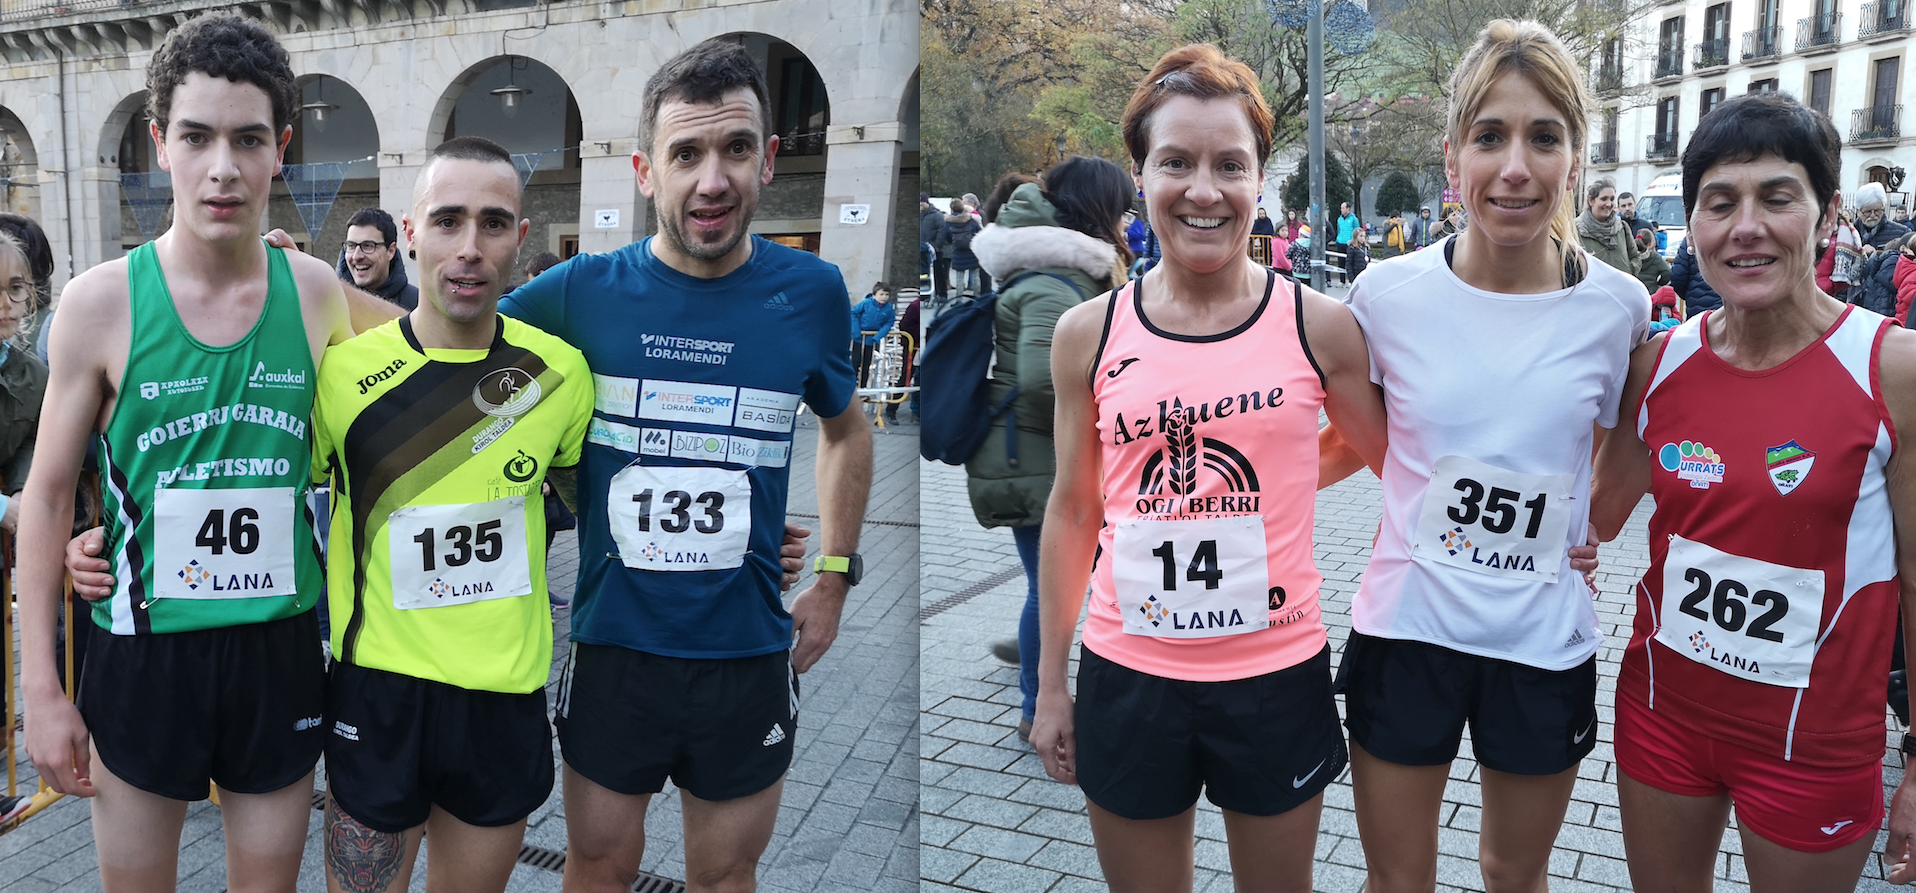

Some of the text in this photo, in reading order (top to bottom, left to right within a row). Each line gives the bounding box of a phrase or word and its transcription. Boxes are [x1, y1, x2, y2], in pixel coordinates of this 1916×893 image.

[645, 347, 727, 366] LORAMENDI
[655, 335, 734, 354] INTERSPORT
[265, 368, 304, 384] auxkal
[657, 391, 732, 407] INTERSPORT
[661, 403, 714, 414] LORAMENDI
[746, 396, 779, 404] AKADEMIA
[137, 403, 306, 452] GOIERRI GARAIA
[1114, 387, 1284, 445] Azkuene
[472, 417, 503, 443] DURANGO
[474, 419, 512, 451] KIROL TALDEA
[155, 458, 290, 489] ATLETISMO
[1680, 461, 1724, 474] URRATS
[632, 488, 725, 534] 133
[1136, 496, 1260, 514] OGI BERRI
[1446, 478, 1547, 539] 351
[195, 507, 260, 555] 46
[413, 518, 503, 572] 135
[664, 552, 709, 563] LANA
[1152, 539, 1223, 591] 14
[1471, 547, 1535, 572] LANA
[213, 572, 274, 591] LANA
[452, 581, 494, 597] LANA
[1678, 567, 1789, 644] 262
[1173, 608, 1245, 630] LANA
[1710, 648, 1760, 673] LANA
